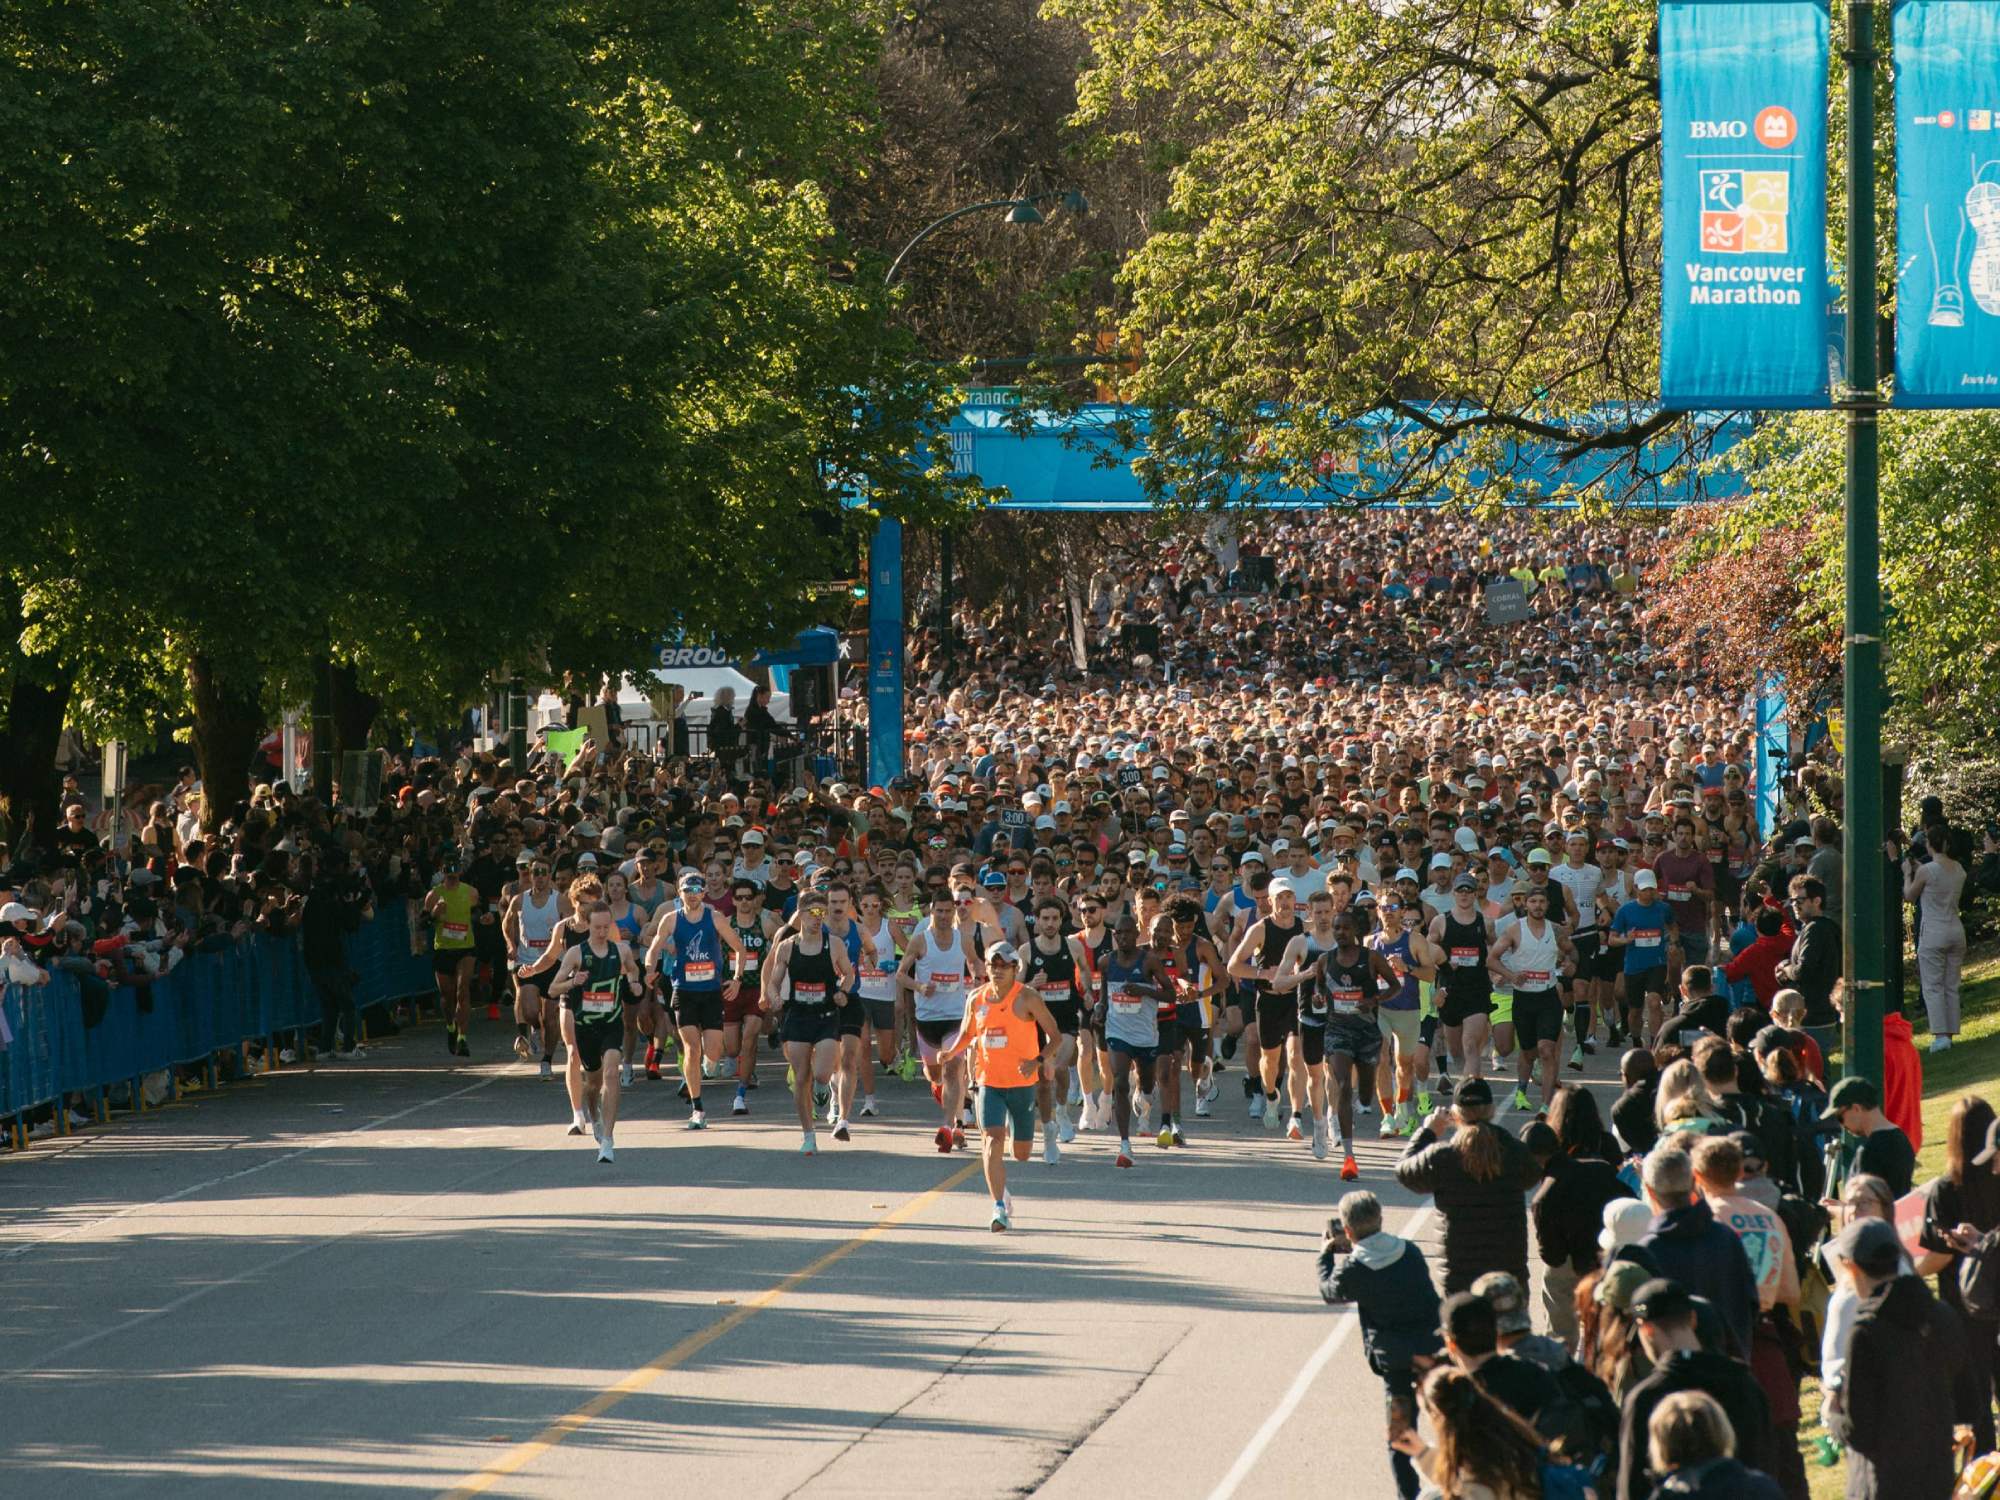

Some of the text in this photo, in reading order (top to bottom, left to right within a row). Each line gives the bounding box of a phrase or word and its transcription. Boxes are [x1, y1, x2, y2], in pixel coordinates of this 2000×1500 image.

[1690, 121, 1747, 138] BMO
[1686, 263, 1806, 282] Vancouver
[1690, 285, 1801, 304] Marathon
[1004, 811, 1025, 824] 3:00
[1731, 1214, 1776, 1229] OBEY
